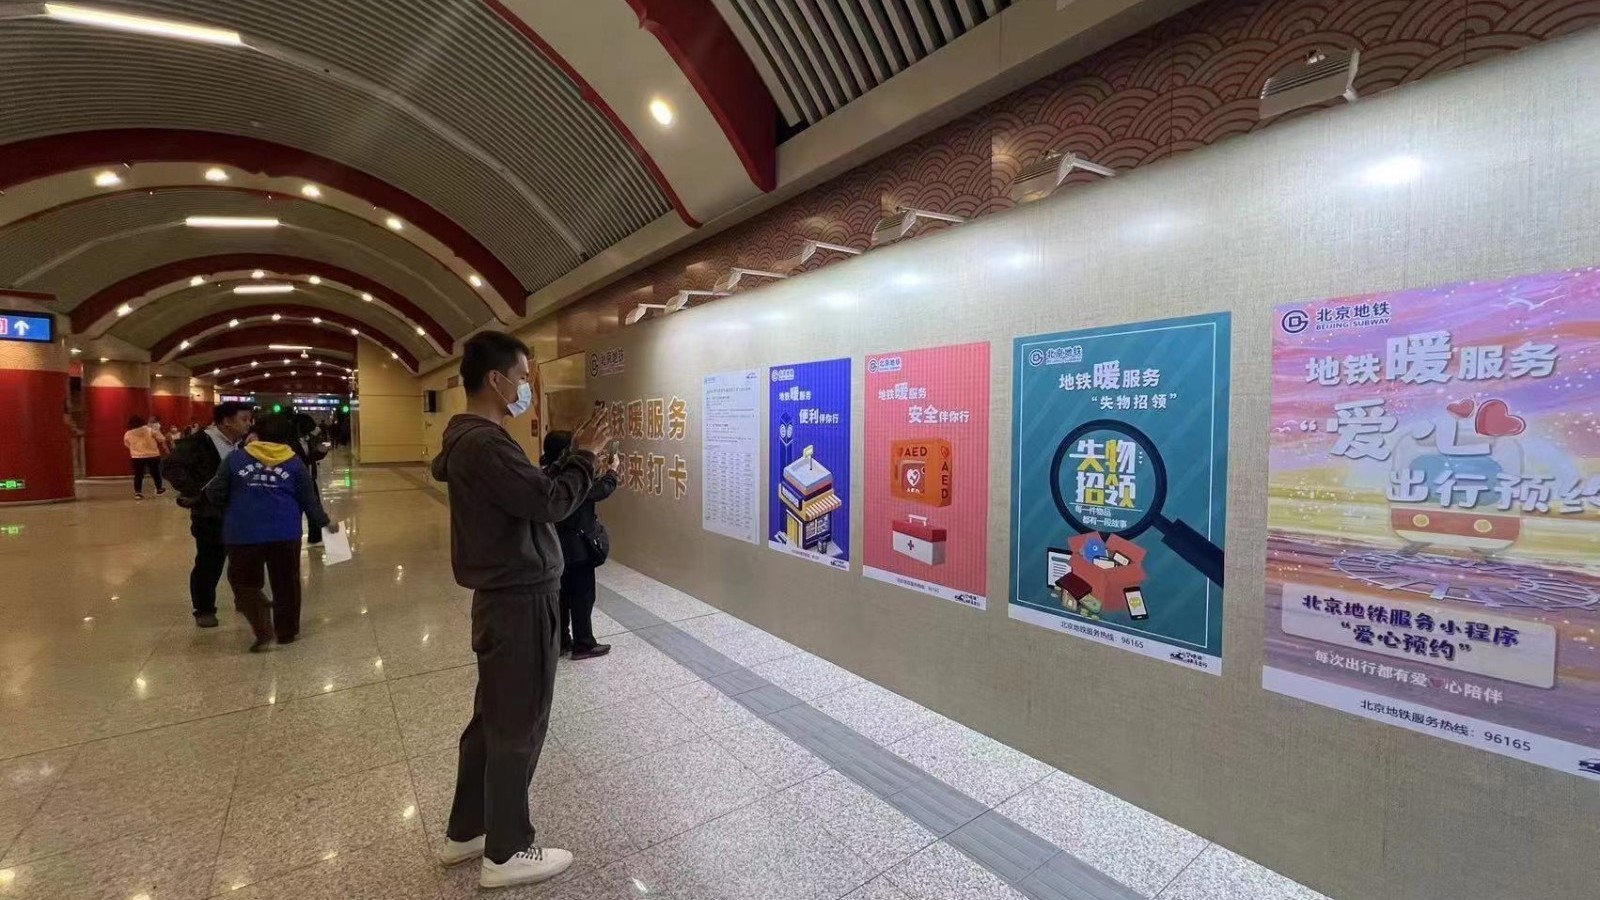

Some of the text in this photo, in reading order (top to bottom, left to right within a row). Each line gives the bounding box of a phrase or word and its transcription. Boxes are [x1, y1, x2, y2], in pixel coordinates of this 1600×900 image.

[1316, 301, 1390, 322] 北京地铁
[1316, 318, 1390, 330] BEIJING SUBWAY
[1045, 346, 1083, 360] 北京地铁
[1305, 330, 1559, 386] 地铁暖服务
[1059, 360, 1161, 391] 地铁暖服务
[878, 382, 927, 401] 地铁暖服务
[597, 396, 688, 441] 铁暖服务
[799, 408, 839, 424] 便利伴你行
[909, 404, 970, 424] 安全伴你行
[904, 446, 928, 457] AED
[941, 461, 950, 499] AED
[1082, 515, 1128, 529] 都有一段故事
[1302, 594, 1520, 648] 北京地铁服务小程序
